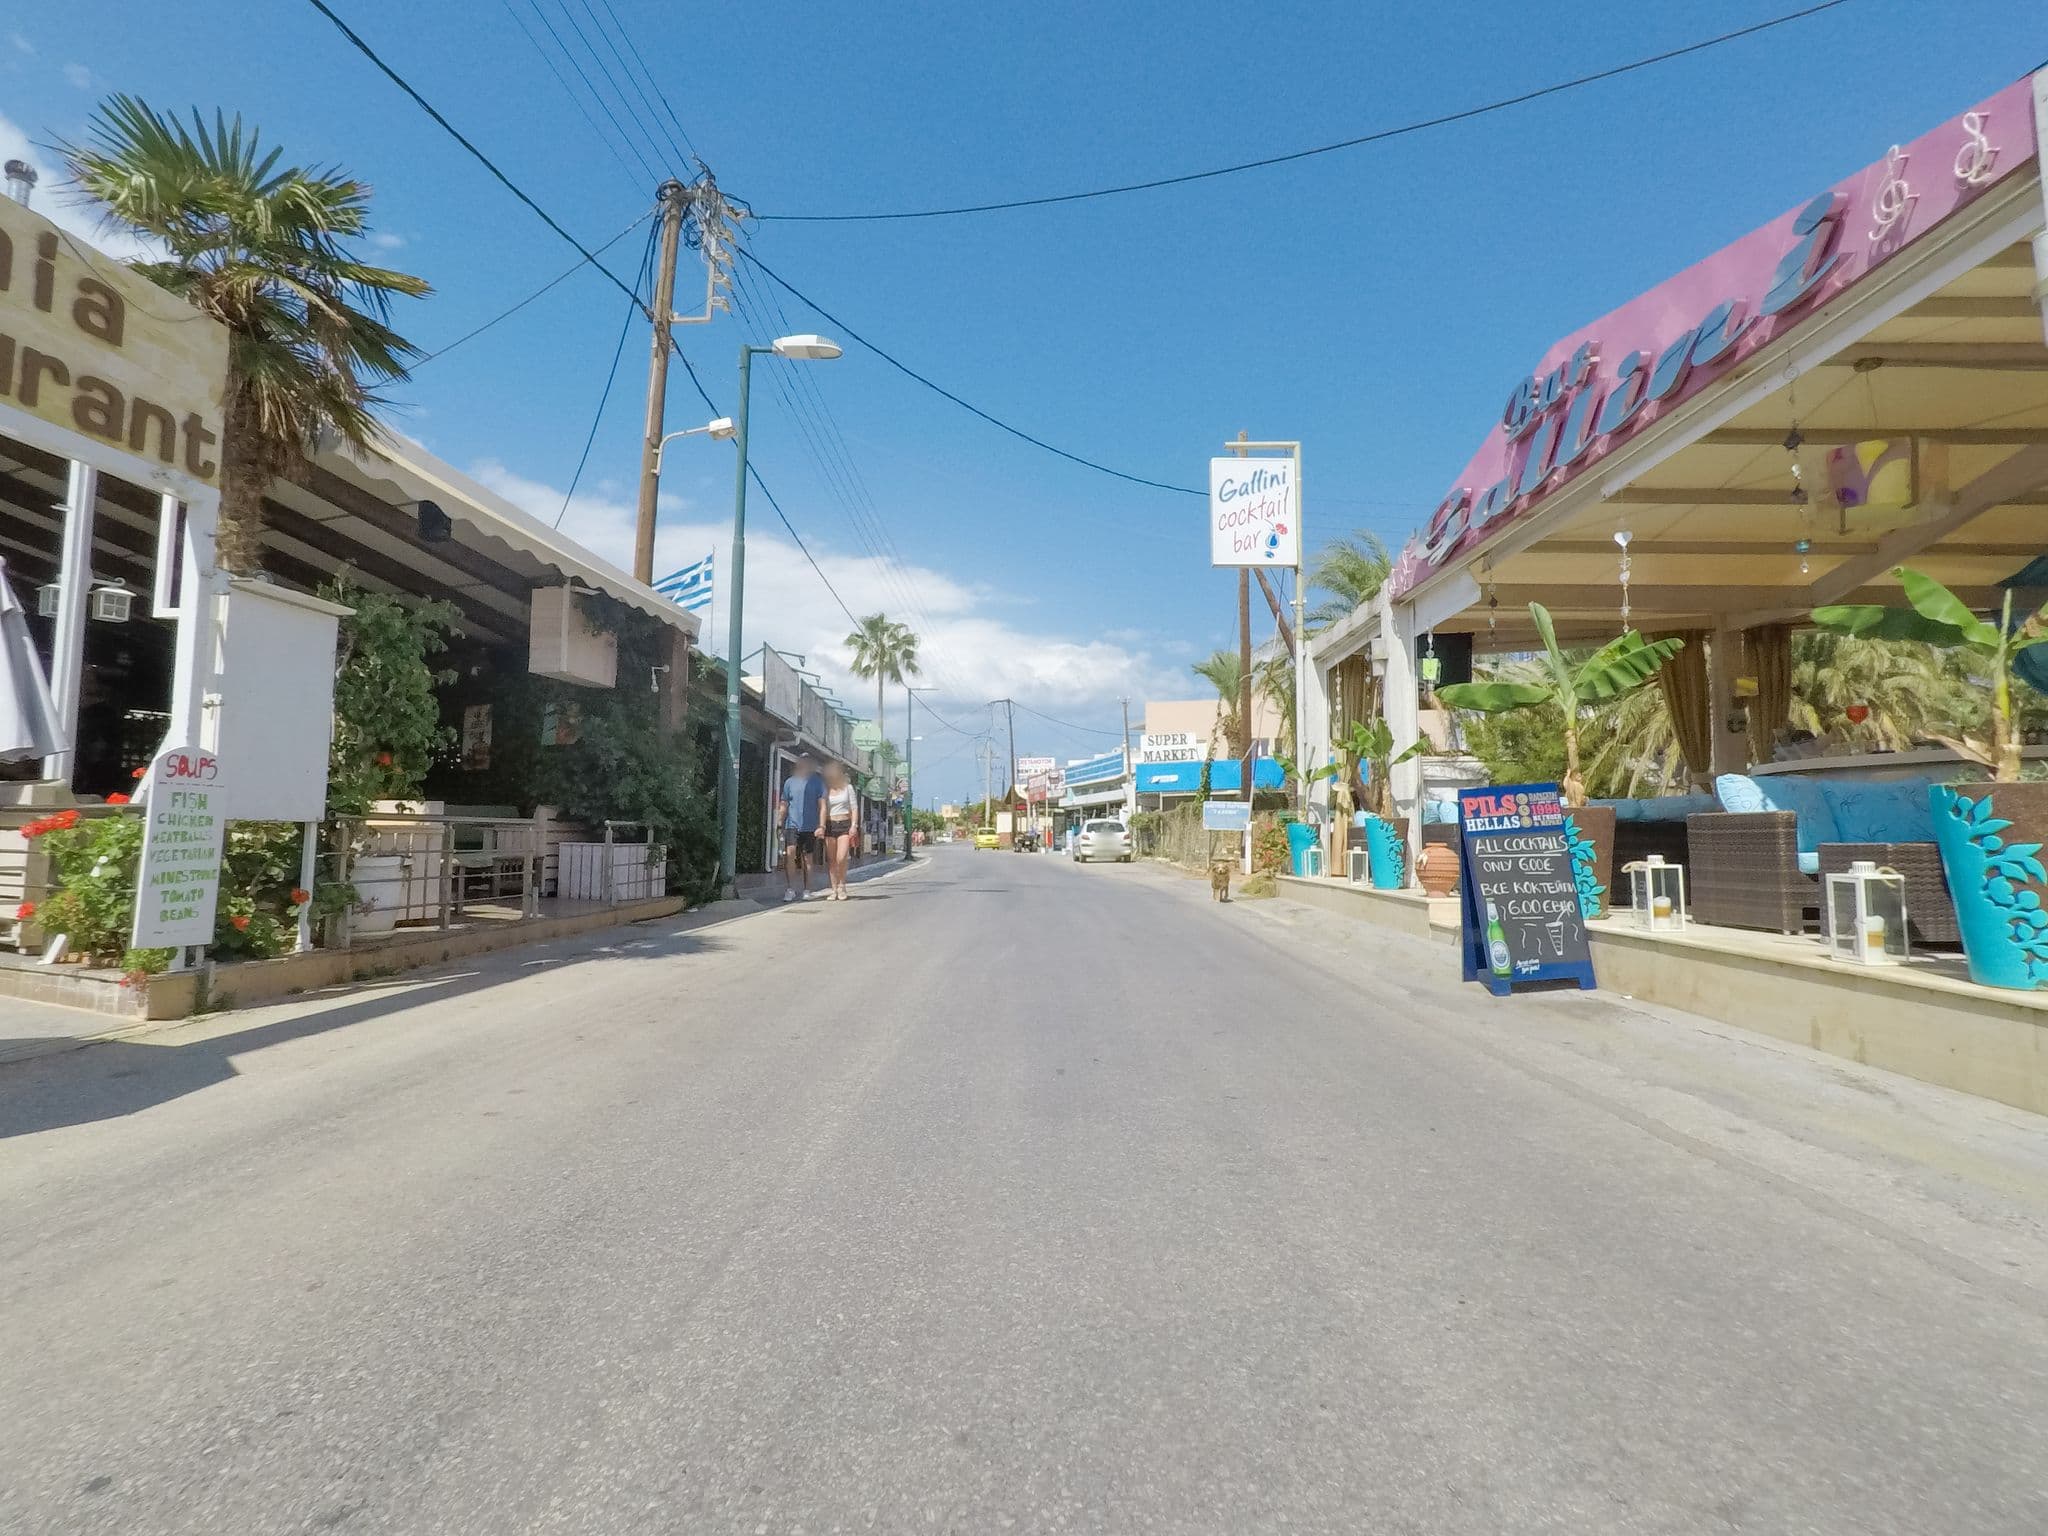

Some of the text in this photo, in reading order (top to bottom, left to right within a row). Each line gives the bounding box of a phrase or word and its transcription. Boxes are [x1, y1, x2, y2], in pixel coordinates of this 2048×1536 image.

[0, 227, 125, 347] ia
[1413, 191, 1848, 568] Gallini
[0, 333, 217, 479] rant
[1219, 465, 1287, 502] Gallini
[1218, 486, 1290, 531] cocktail
[1233, 530, 1261, 553] bar
[1147, 733, 1188, 746] SUPER
[1143, 748, 1197, 762] MARKET
[165, 754, 219, 780] SOUPS
[171, 791, 208, 810] FISH
[1463, 794, 1517, 819] PILS
[157, 812, 214, 827] CHICKEN
[1465, 815, 1520, 832] HELLAS
[1475, 835, 1569, 855] ALL COCKTAILS
[1482, 859, 1512, 873] ONLY
[1480, 881, 1510, 896] ВСЕ
[160, 906, 200, 922] BEANS
